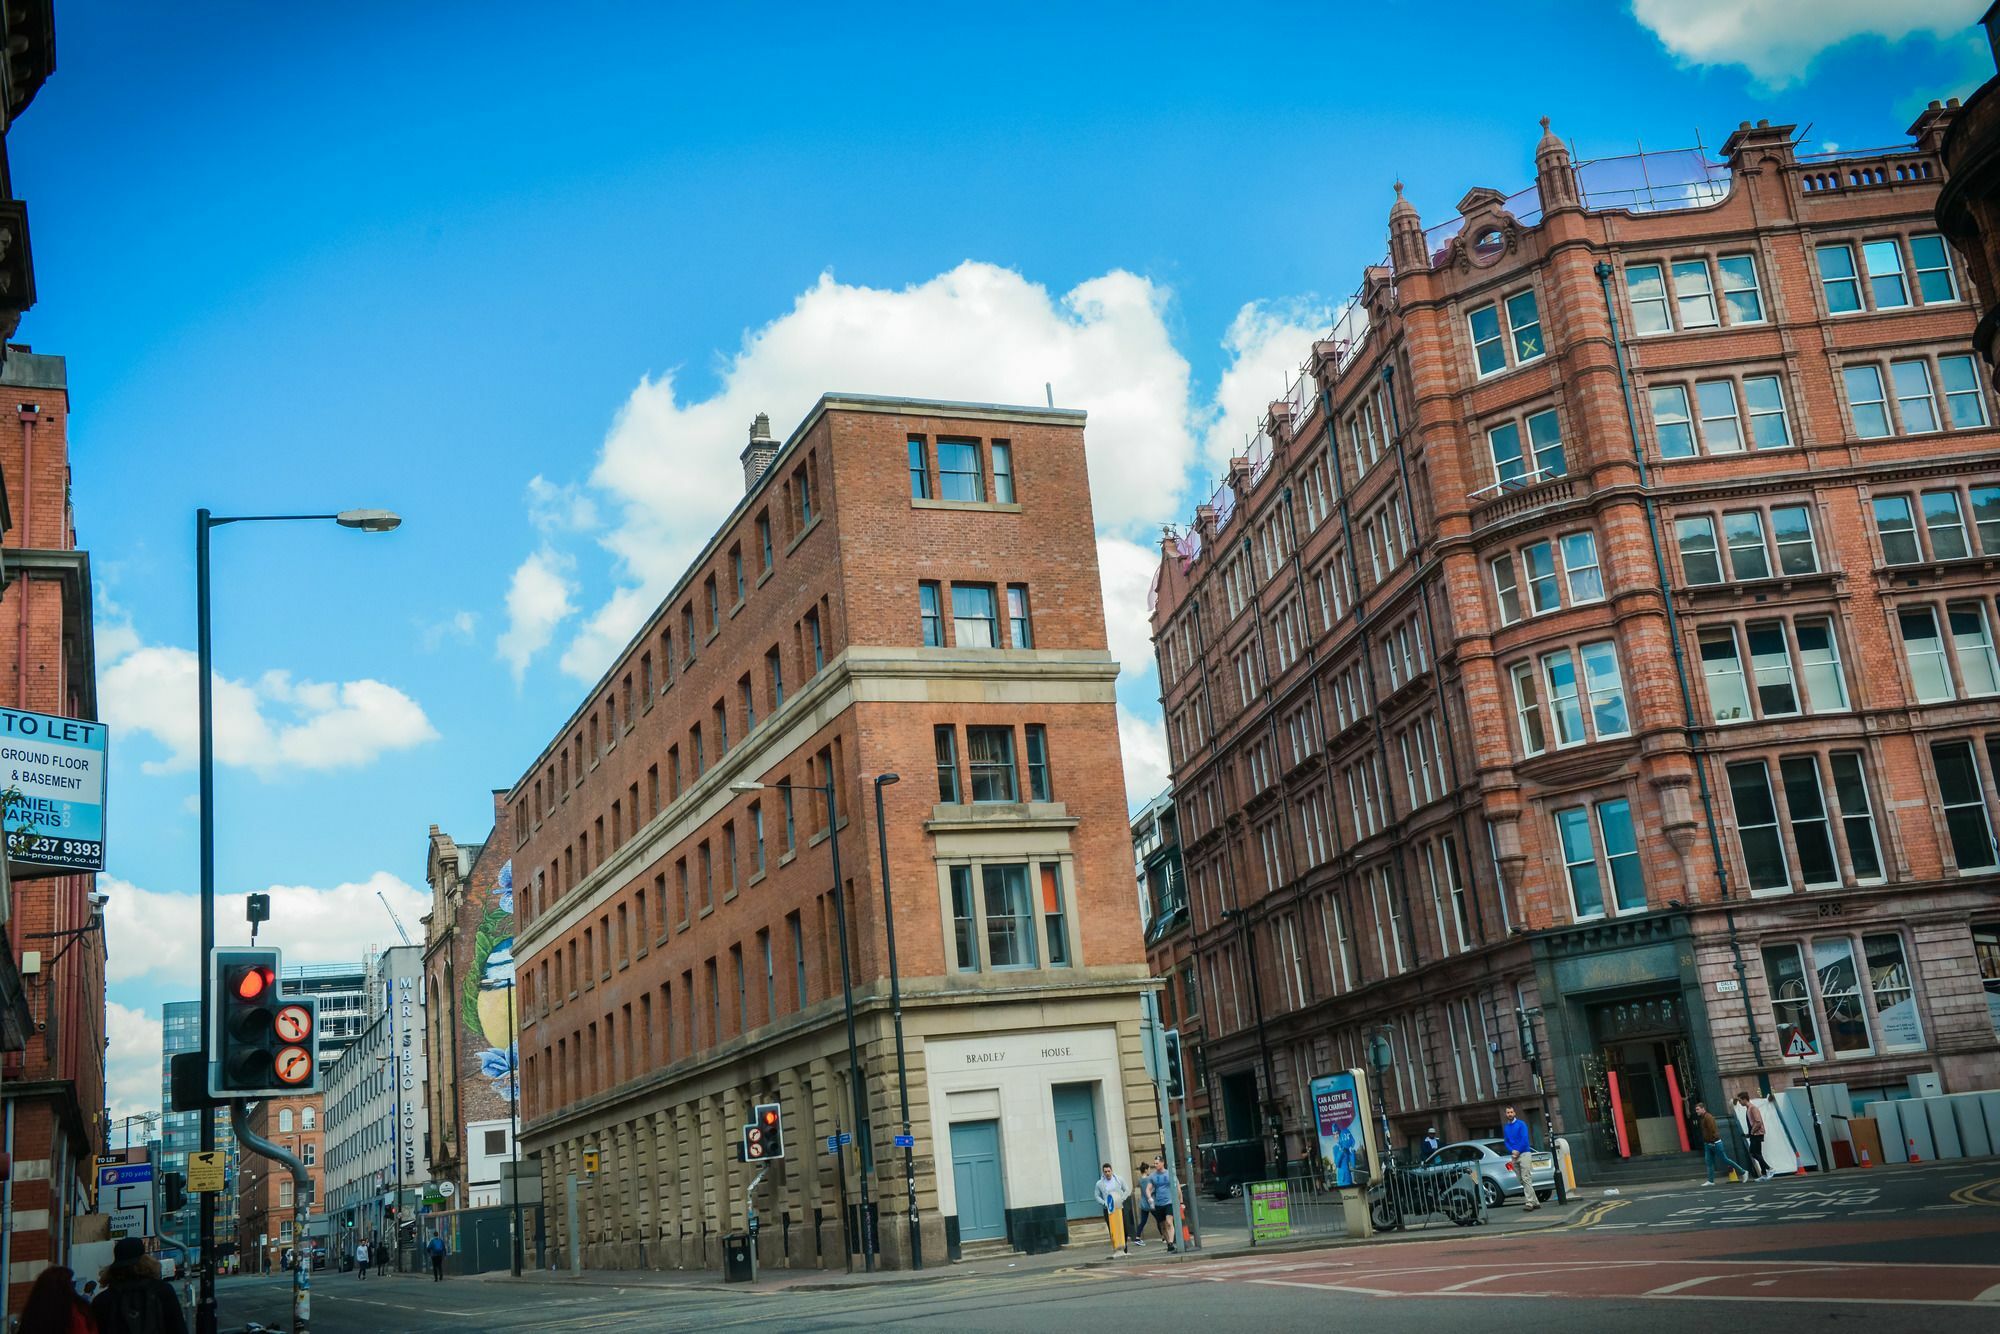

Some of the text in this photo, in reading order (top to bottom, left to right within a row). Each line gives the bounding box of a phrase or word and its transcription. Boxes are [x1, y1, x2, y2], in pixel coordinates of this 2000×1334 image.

[2, 712, 95, 744] TO LET
[1, 748, 89, 771] GROUND FLOOR
[11, 769, 82, 790] & BASEMENT
[5, 797, 59, 813] ANIEL
[7, 834, 101, 857] 61 237 9393
[1680, 955, 1692, 967] 35
[966, 1047, 1071, 1064] BRADLEY HOUSE
[399, 976, 415, 1177] MARLSBRO HOUSE
[1331, 1094, 1341, 1102] CITY
[1341, 1092, 1347, 1100] BE
[1328, 1101, 1352, 1111] CHARMING?
[134, 1170, 151, 1178] yards
[1719, 1188, 1880, 1203] ONLY
[1667, 1195, 1880, 1217] BUSES
